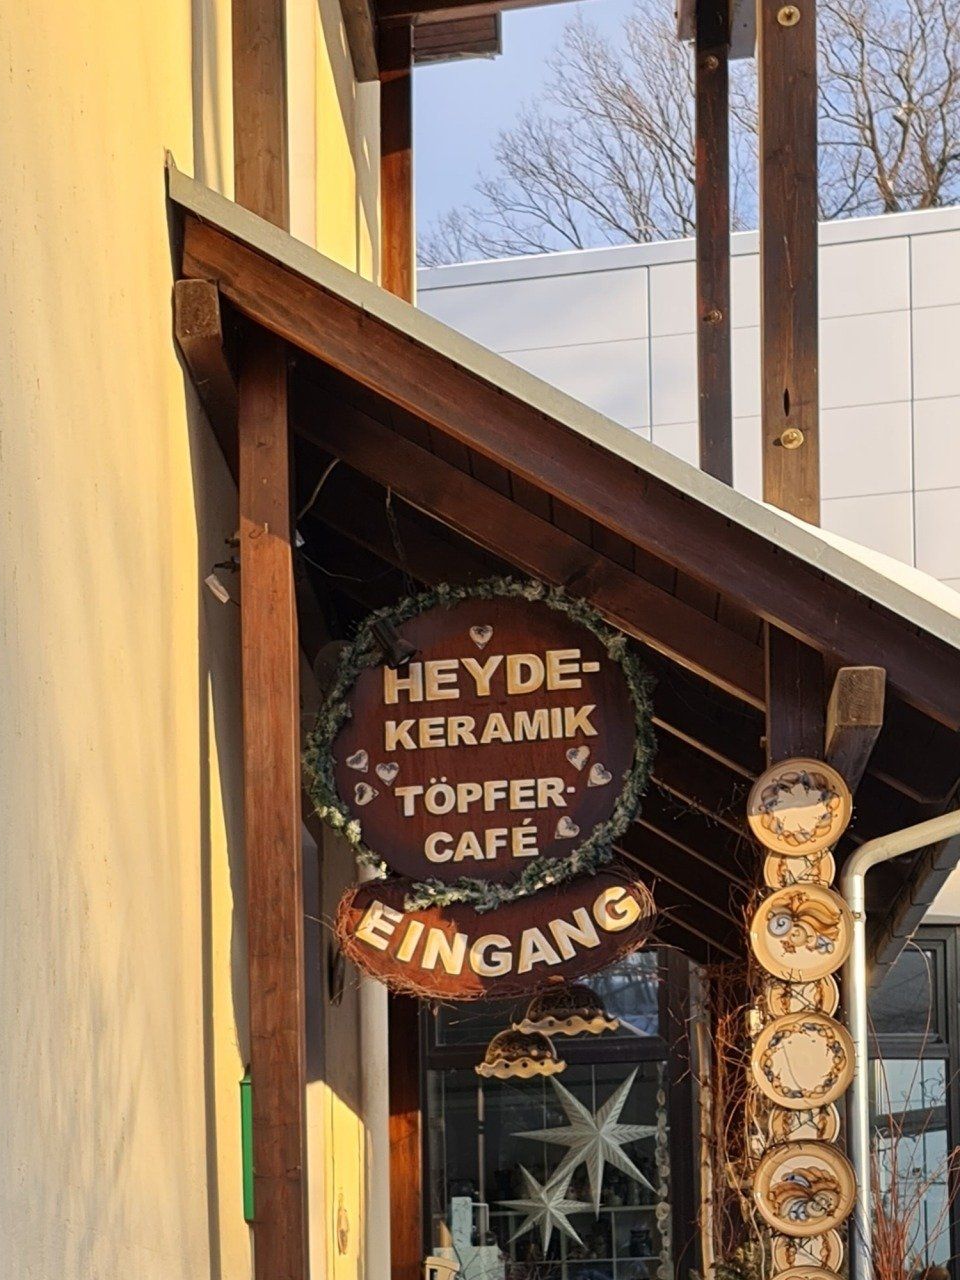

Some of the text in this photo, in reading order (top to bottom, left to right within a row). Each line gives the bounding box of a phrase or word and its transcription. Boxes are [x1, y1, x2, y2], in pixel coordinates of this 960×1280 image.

[384, 648, 600, 704] HEYDE-
[385, 704, 599, 751] KERAMIK
[395, 776, 576, 817] TÖPFER-
[424, 818, 539, 863] CAFÉ
[355, 886, 641, 977] EINGANG
